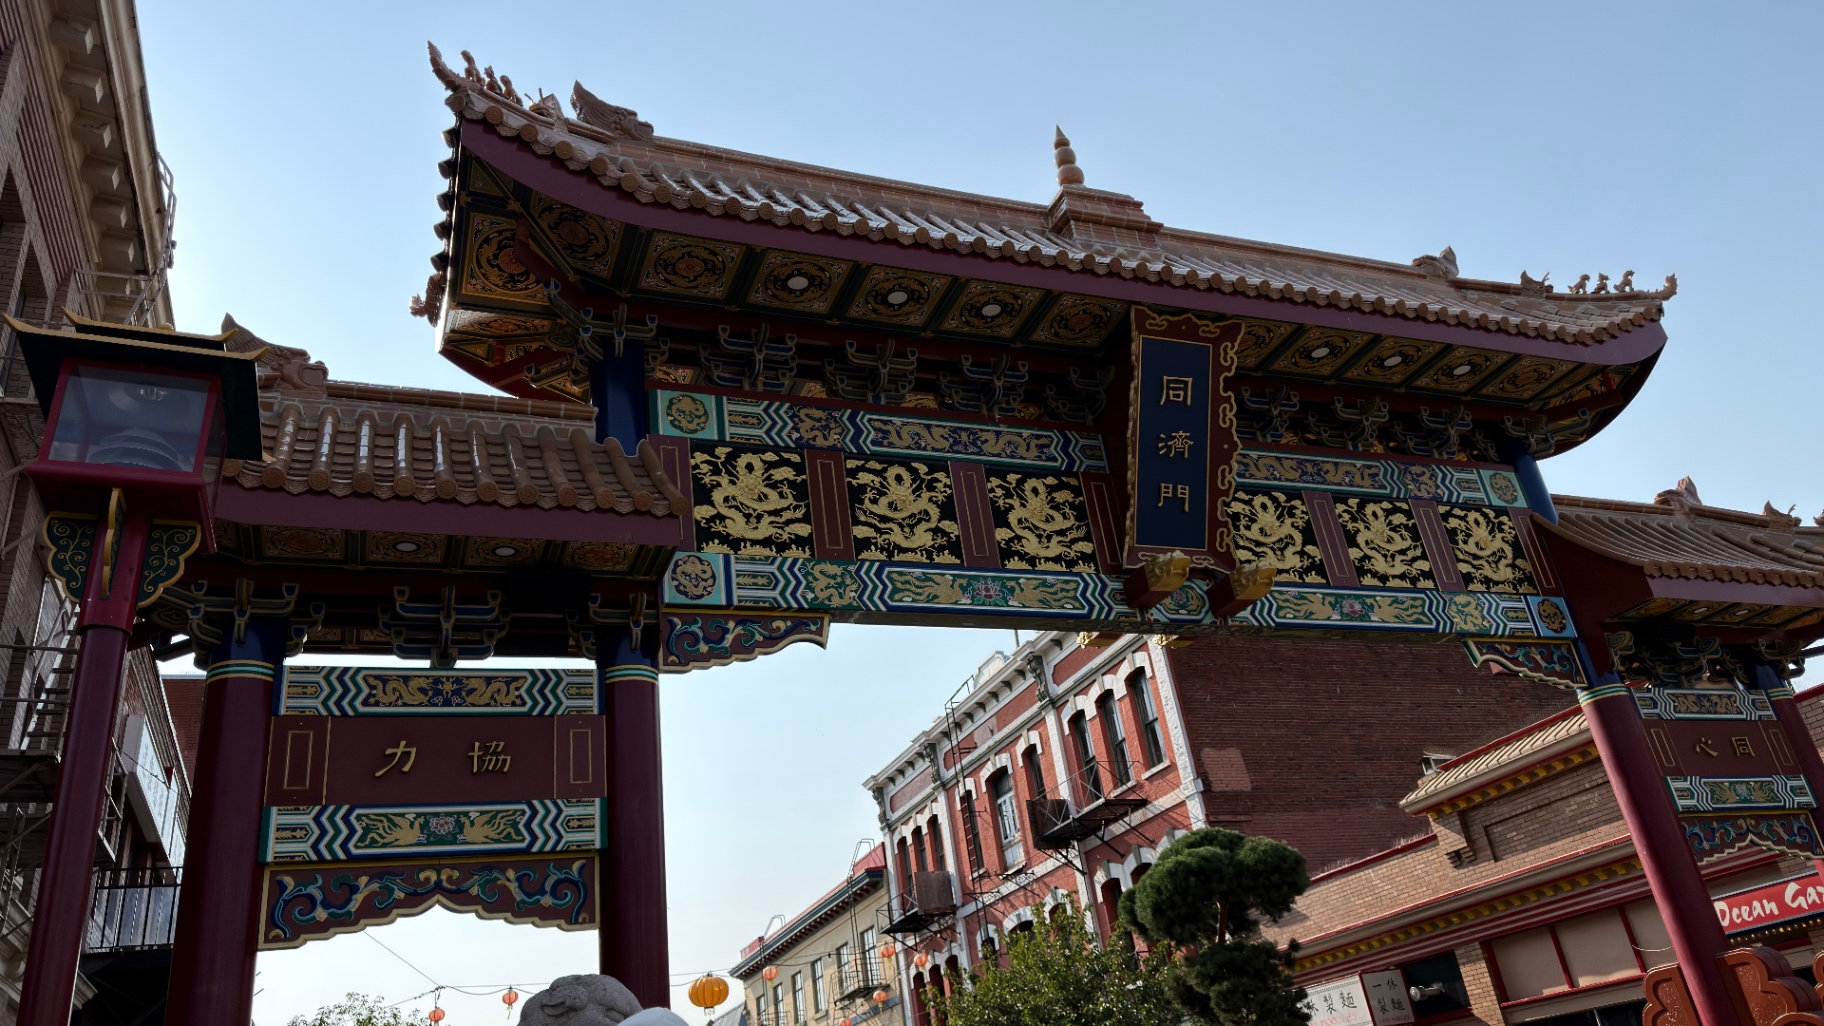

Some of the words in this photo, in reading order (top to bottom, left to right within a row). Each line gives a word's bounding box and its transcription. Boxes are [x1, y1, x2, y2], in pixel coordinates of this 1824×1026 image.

[1157, 375, 1194, 513] 同濟門
[1713, 900, 1779, 927] Ocean
